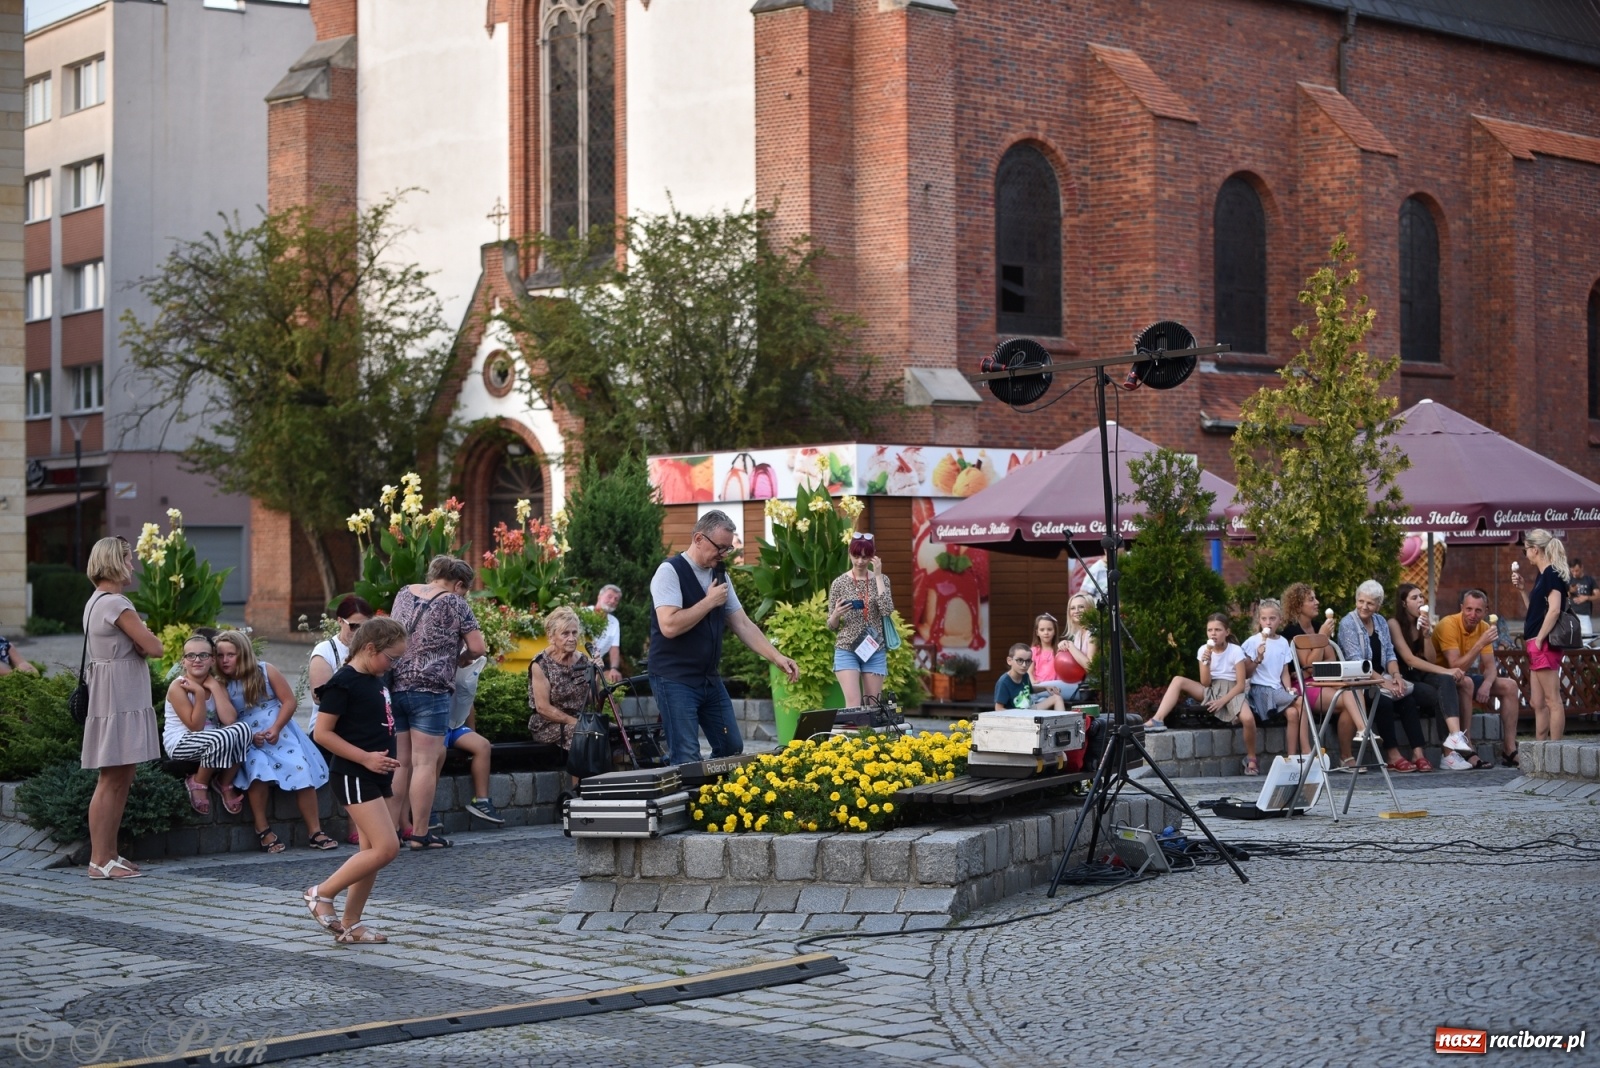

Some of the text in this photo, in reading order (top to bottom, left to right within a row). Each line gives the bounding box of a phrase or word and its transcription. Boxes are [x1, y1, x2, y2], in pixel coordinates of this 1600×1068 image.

[1426, 511, 1469, 525] Italia
[1494, 509, 1541, 528] Gelateria
[1544, 508, 1568, 522] Ciao
[936, 522, 1010, 539] Gelateria Ciao Italia
[1031, 521, 1087, 538] Gelateria
[706, 761, 727, 774] Roland
